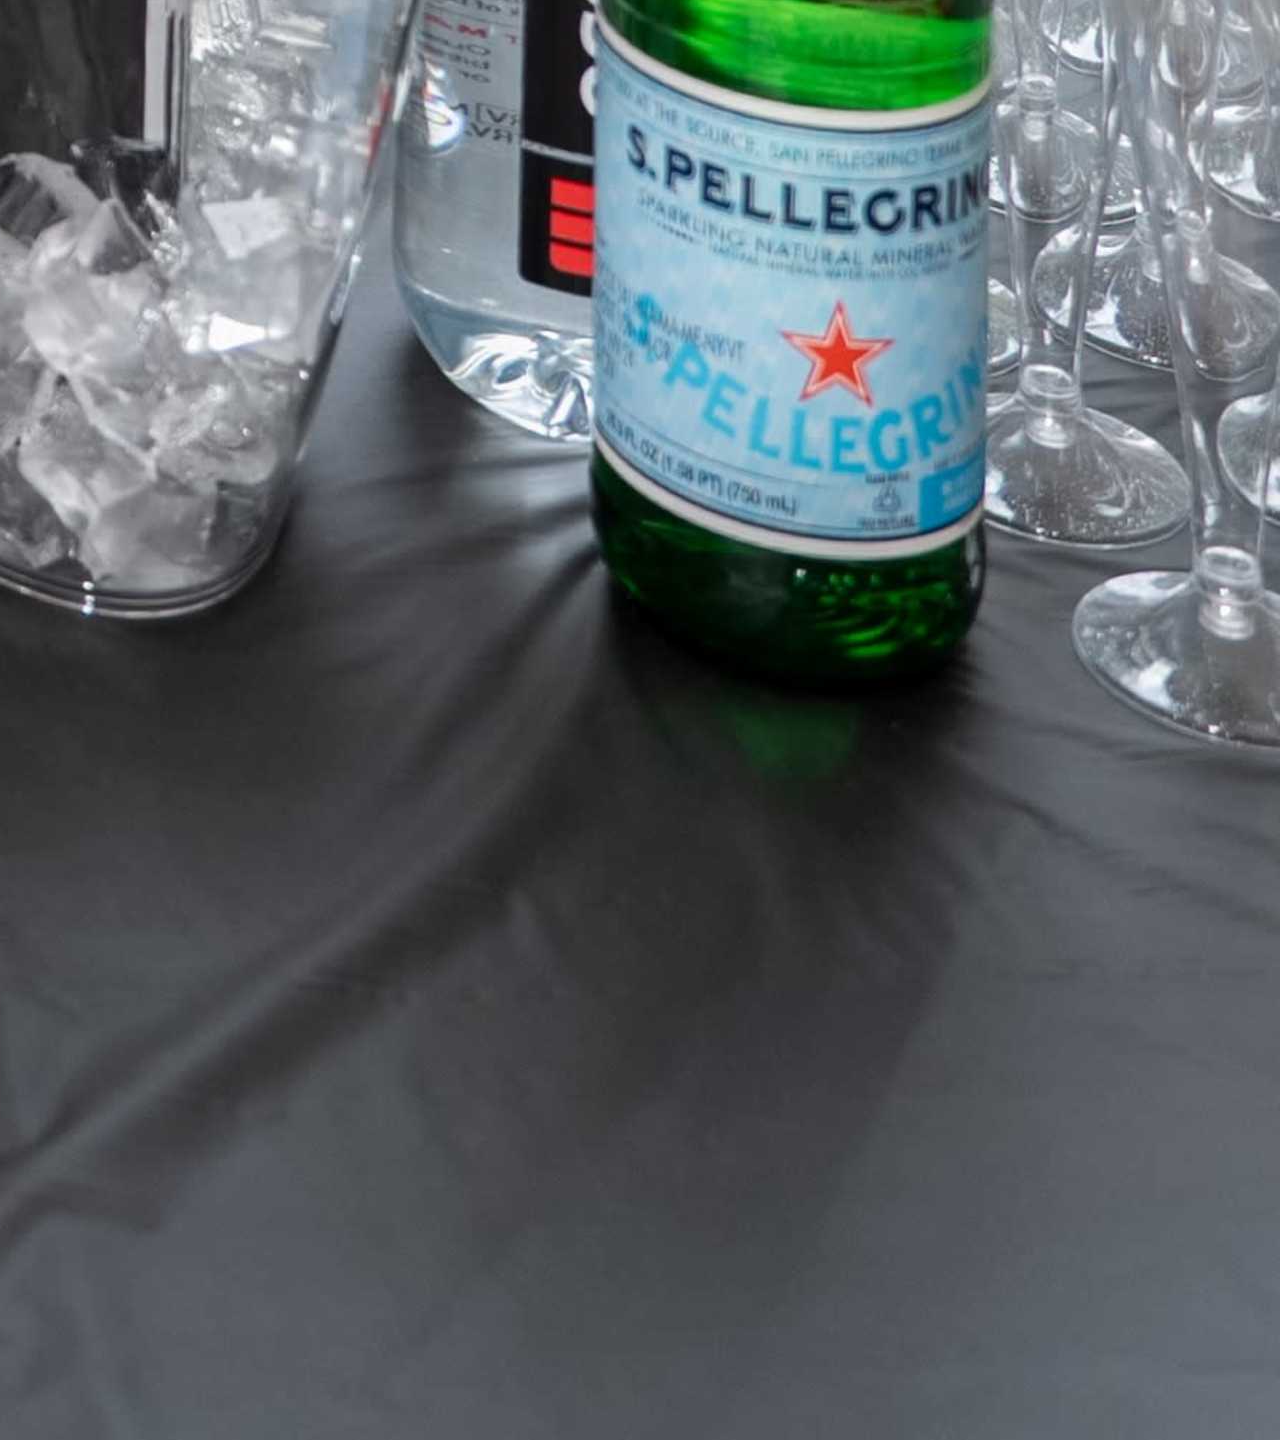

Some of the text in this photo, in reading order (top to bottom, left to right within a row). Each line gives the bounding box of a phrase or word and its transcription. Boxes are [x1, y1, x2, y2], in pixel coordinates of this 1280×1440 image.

[755, 237, 864, 267] NATURAL
[870, 238, 954, 267] MINERAL
[624, 291, 983, 476] S.PELLEGRIN
[727, 480, 761, 505] (750
[764, 493, 797, 518] mL)
